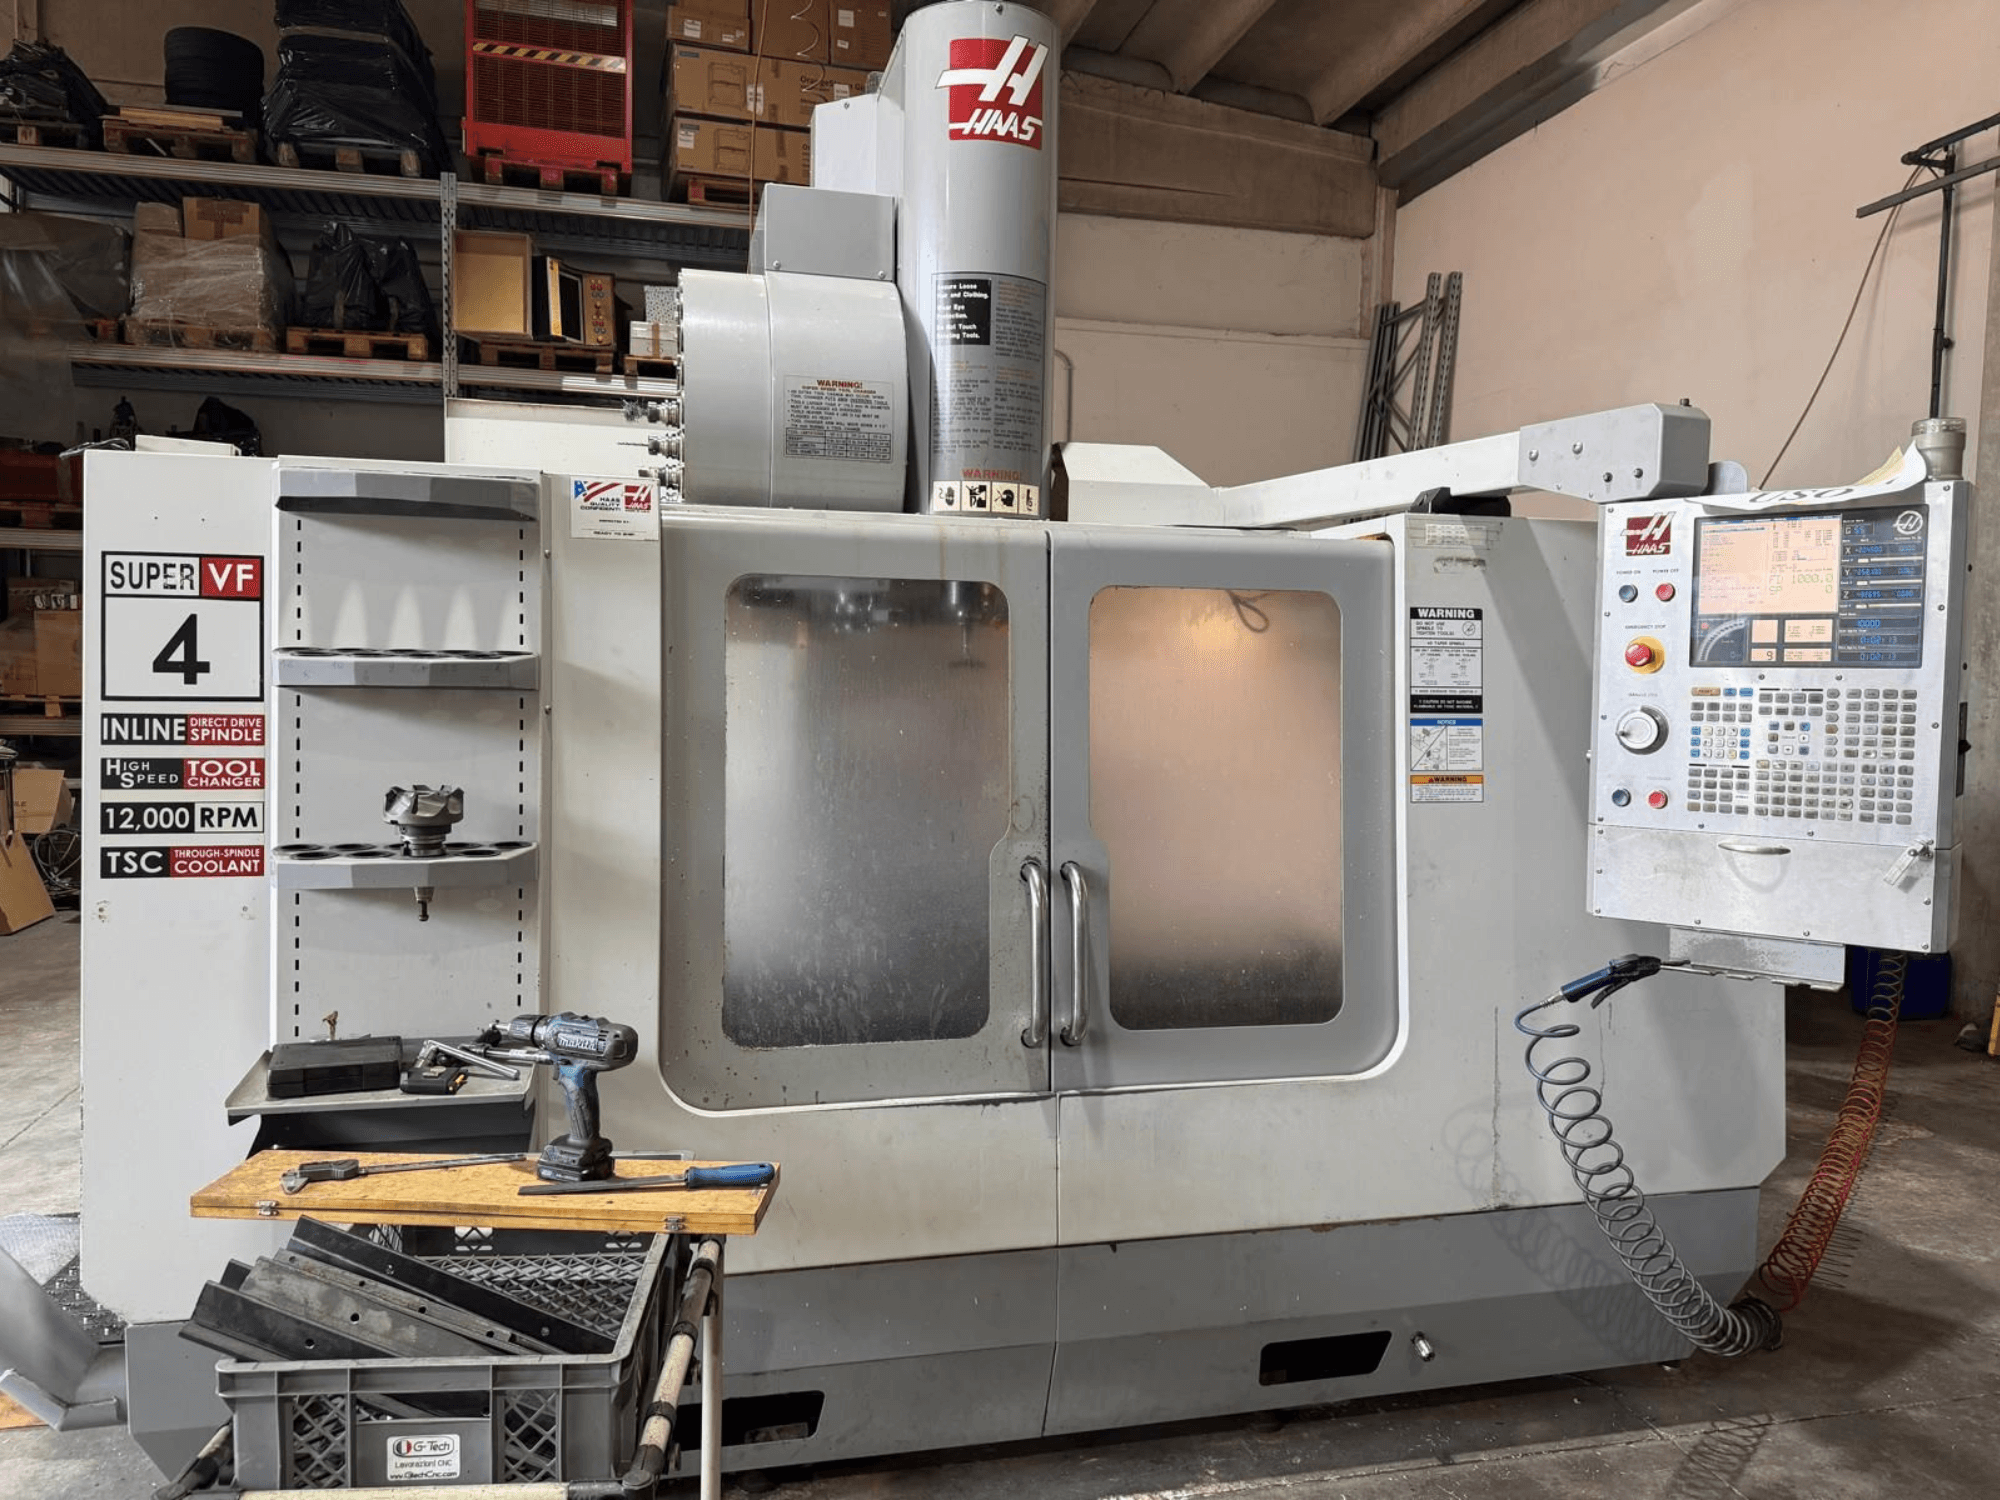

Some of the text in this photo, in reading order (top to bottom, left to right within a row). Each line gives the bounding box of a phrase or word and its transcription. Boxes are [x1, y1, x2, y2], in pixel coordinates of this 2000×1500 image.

[949, 108, 1043, 141] HAAS
[816, 379, 863, 389] WARNING!
[1845, 547, 1851, 555] X
[110, 561, 254, 592] SUPER VF
[1417, 608, 1475, 619] WARNING
[152, 613, 211, 685] 4
[103, 717, 186, 741] INLINE
[190, 717, 262, 727] DIRECT DRIVE
[190, 728, 262, 741] SPINDLE
[187, 760, 261, 777] TOOL
[187, 777, 261, 787] CHANGER
[105, 807, 190, 831] 12,000
[200, 807, 258, 828] RPM
[174, 848, 260, 858] THROUGH-SPINDLE
[106, 851, 163, 874] TSC
[174, 859, 261, 874] COOLANT
[437, 1459, 453, 1467] CNC
